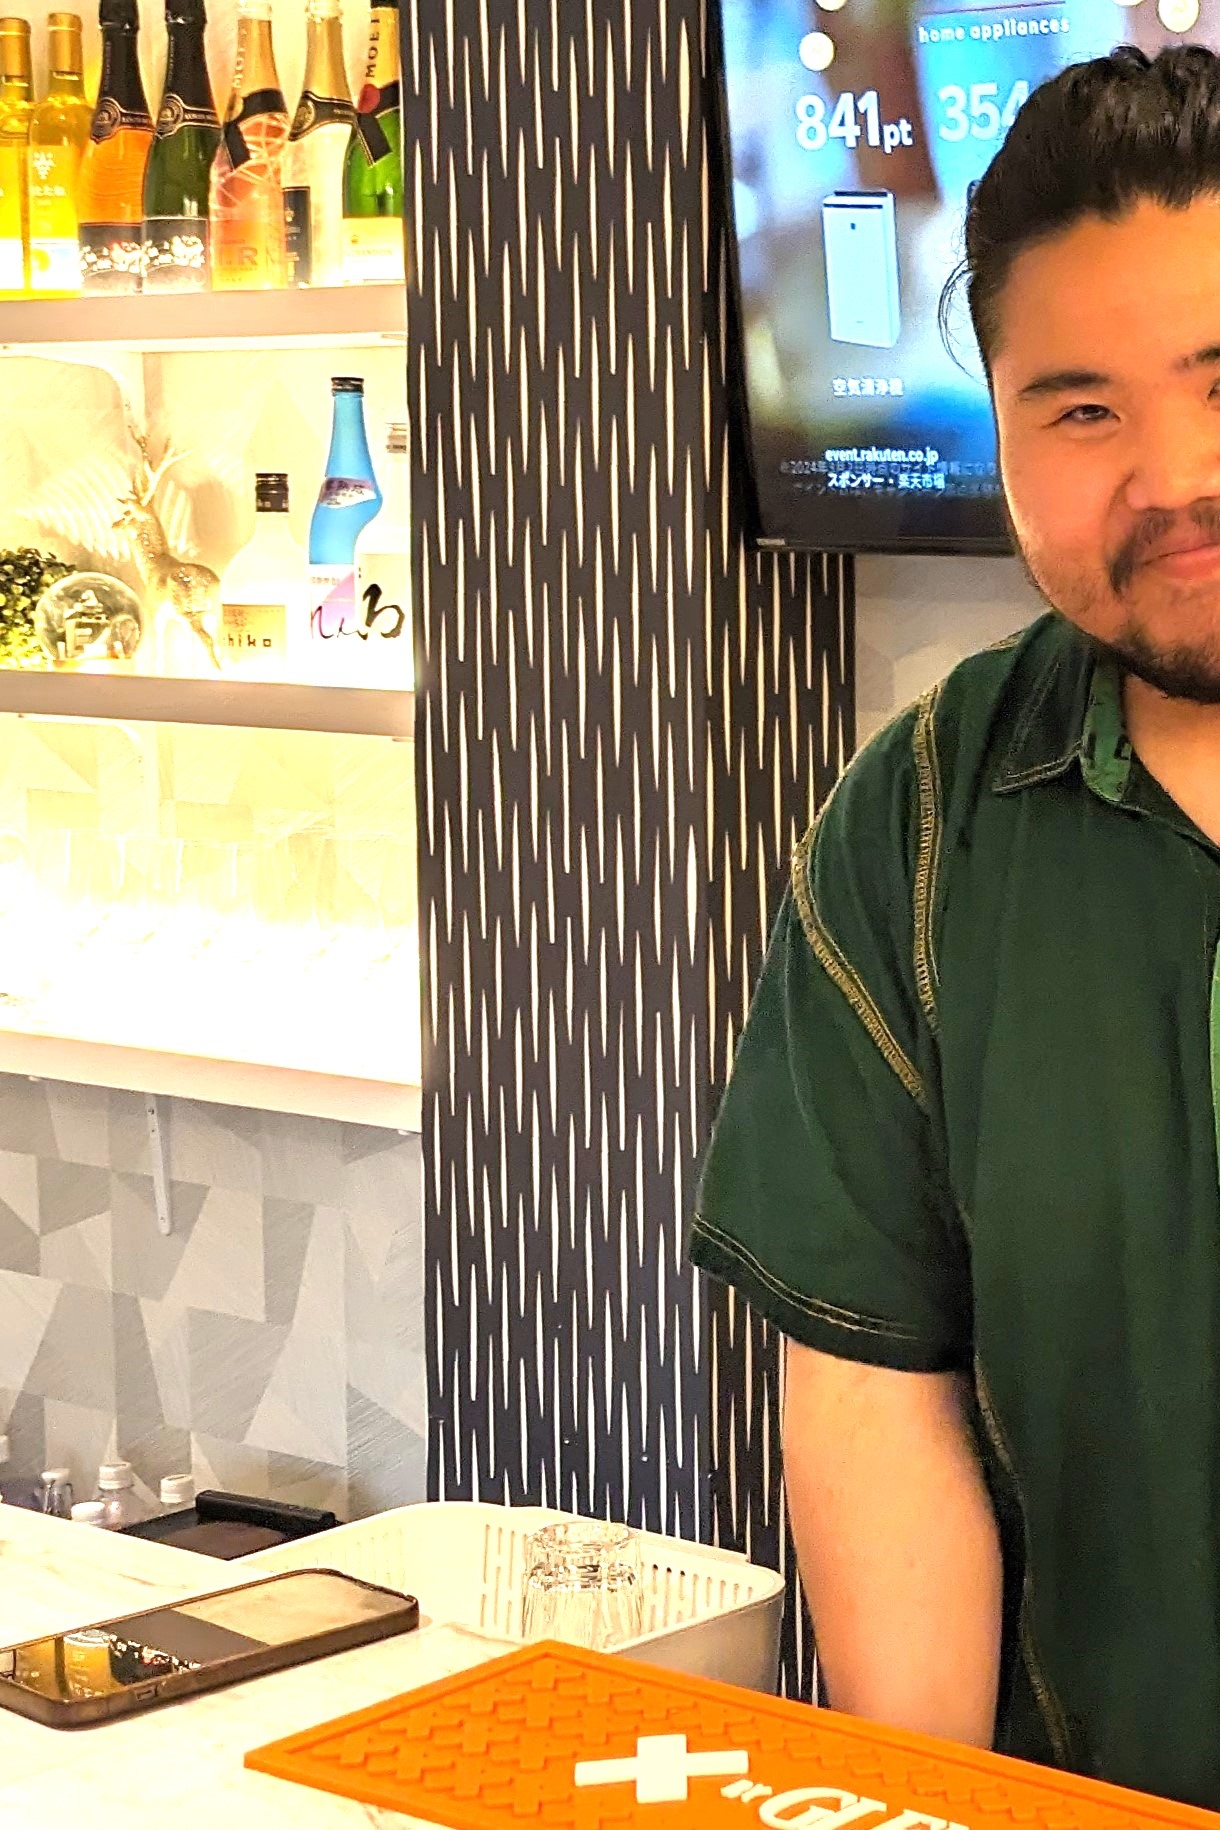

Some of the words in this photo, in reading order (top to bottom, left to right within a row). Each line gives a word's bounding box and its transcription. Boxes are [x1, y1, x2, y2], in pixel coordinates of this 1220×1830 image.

[918, 26, 965, 43] home
[969, 18, 1071, 42] appliances
[796, 90, 914, 153] 841pt
[825, 446, 939, 466] event.rakuten.co.jp
